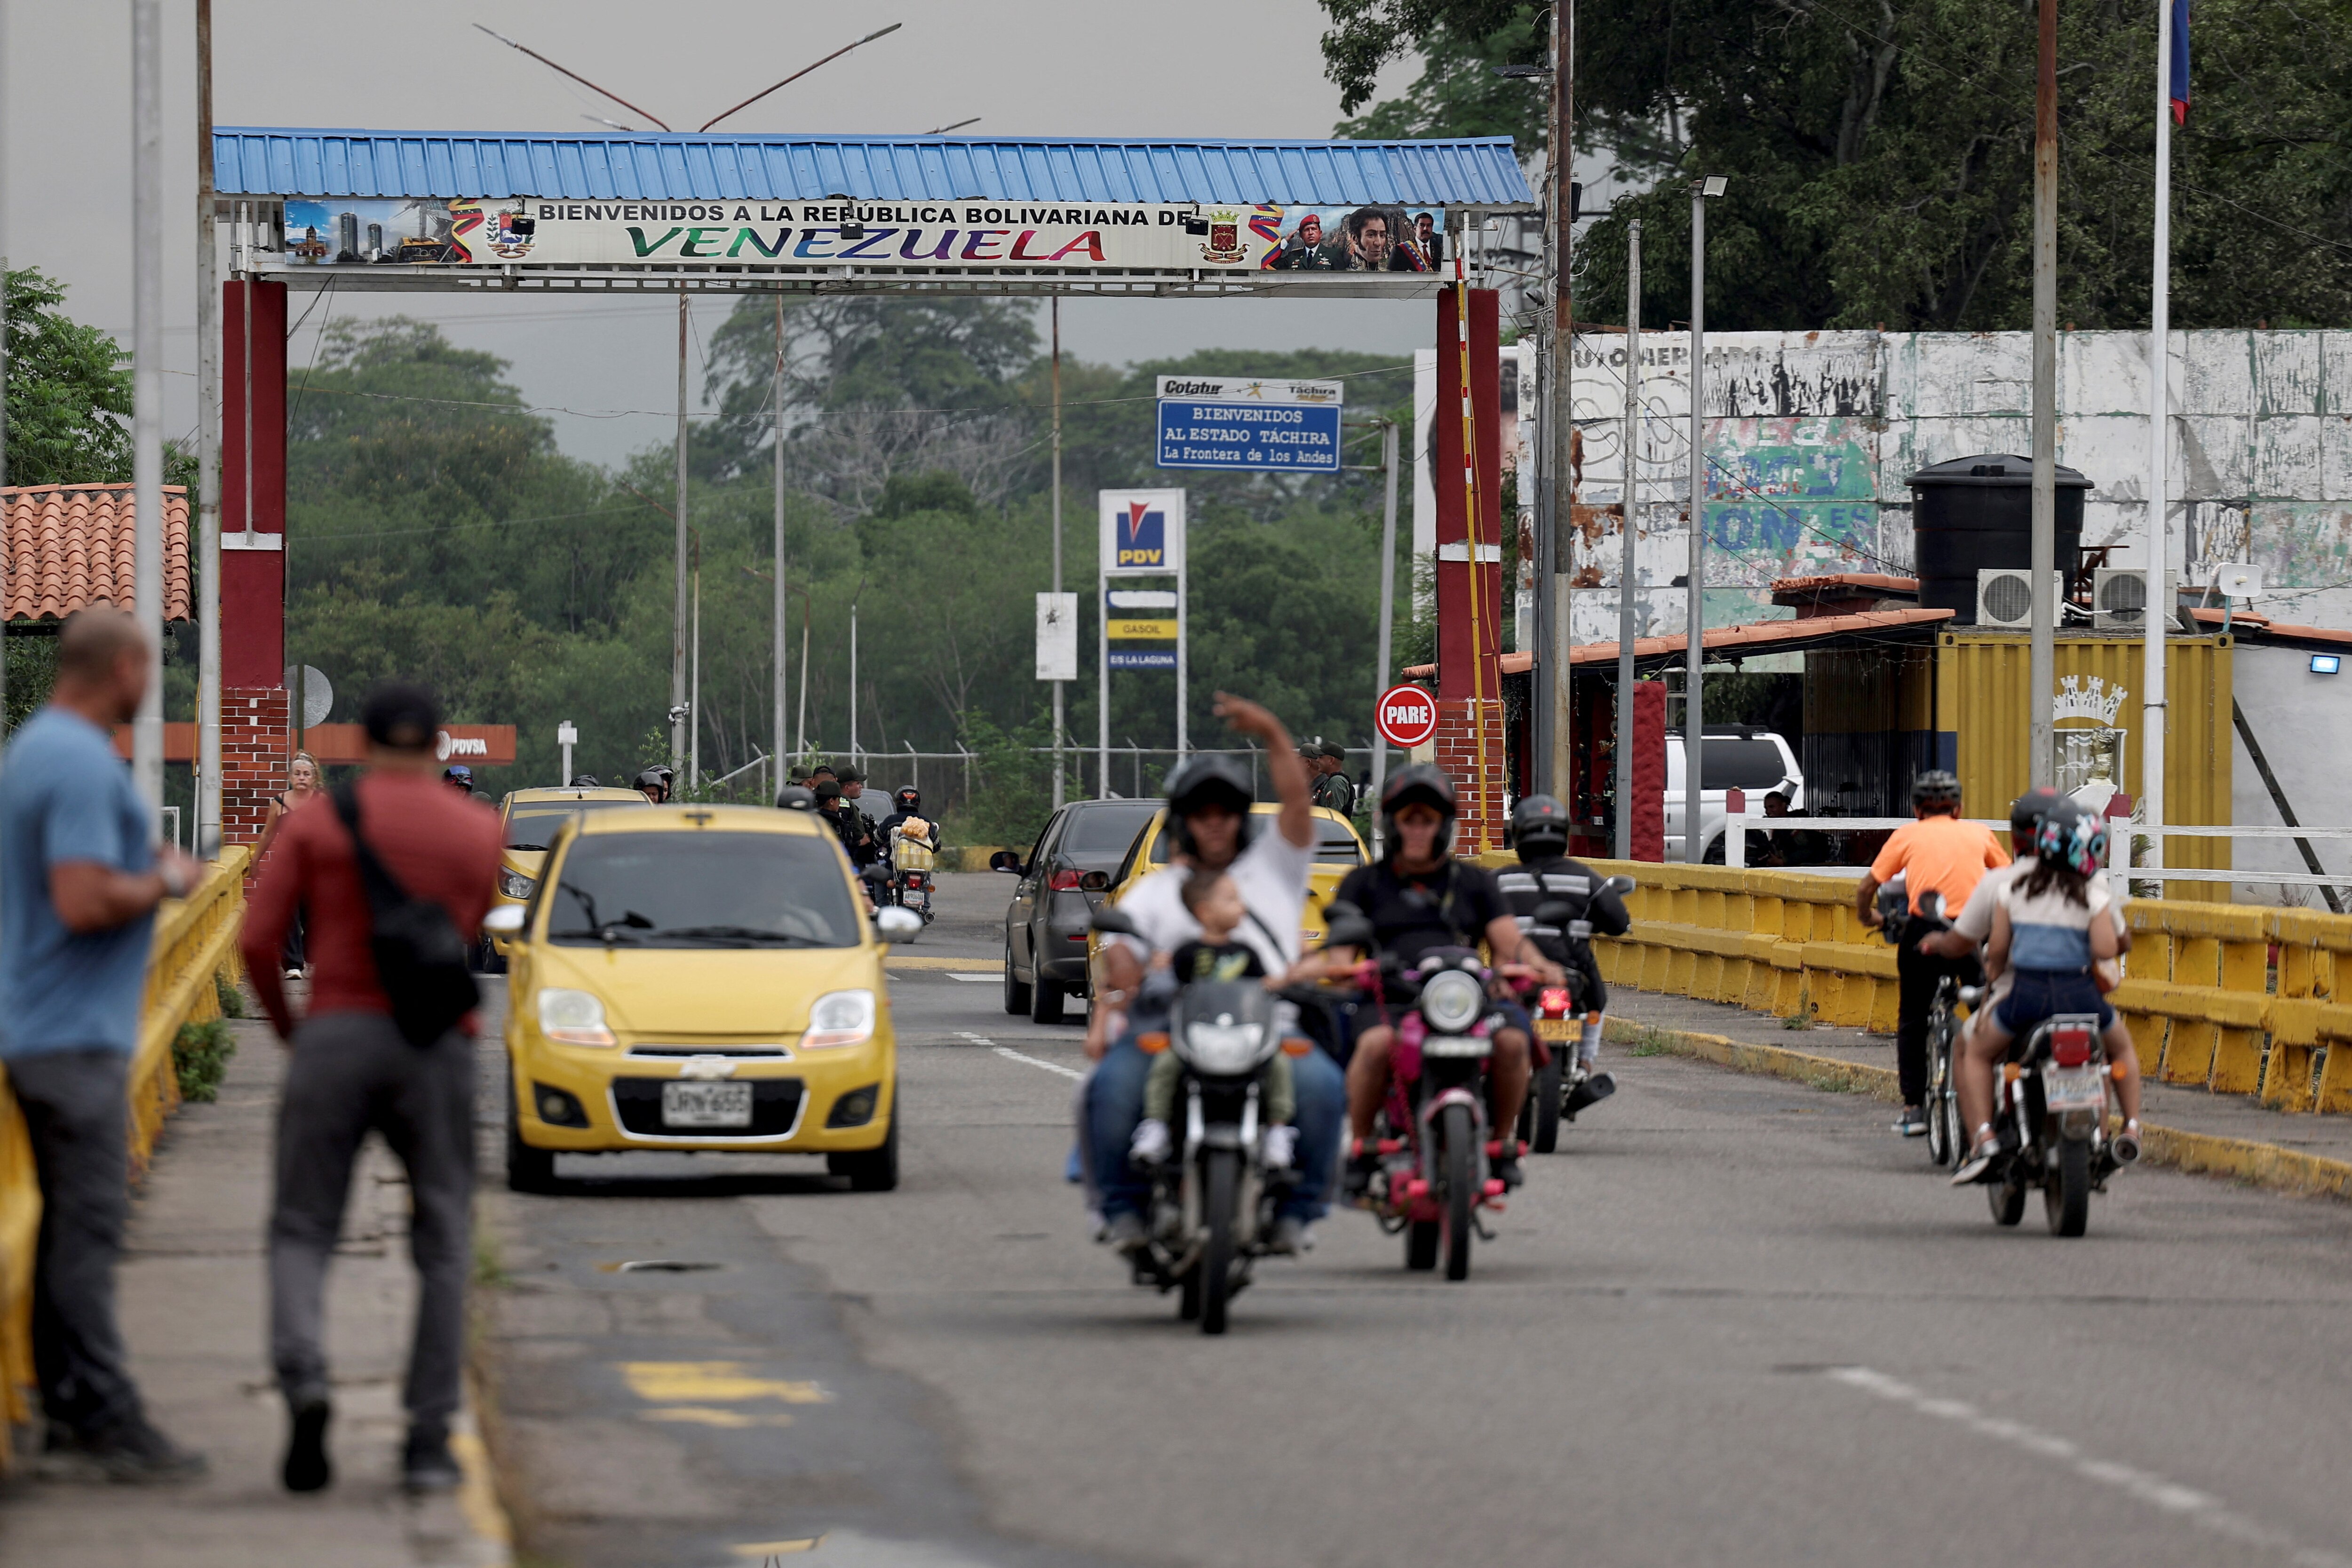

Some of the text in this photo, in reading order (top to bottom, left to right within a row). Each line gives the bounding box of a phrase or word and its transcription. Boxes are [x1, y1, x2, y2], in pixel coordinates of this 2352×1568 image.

[539, 203, 1193, 226] BIENVENIDOS A LA REPÚBLICA BOLIVARIANA DE
[625, 227, 1107, 262] VENEZUELA
[1192, 407, 1303, 423] BIENVENIDOS
[1165, 427, 1331, 445] AL ESTADO TÁCHIRA
[1164, 446, 1334, 464] La Frontera de los Andes
[1119, 549, 1162, 565] PDV
[1123, 624, 1161, 634] GASOIL
[1125, 655, 1137, 664] LA
[1138, 655, 1175, 664] LAGUNA
[1387, 706, 1429, 724] PARE
[452, 739, 487, 755] PDVSA
